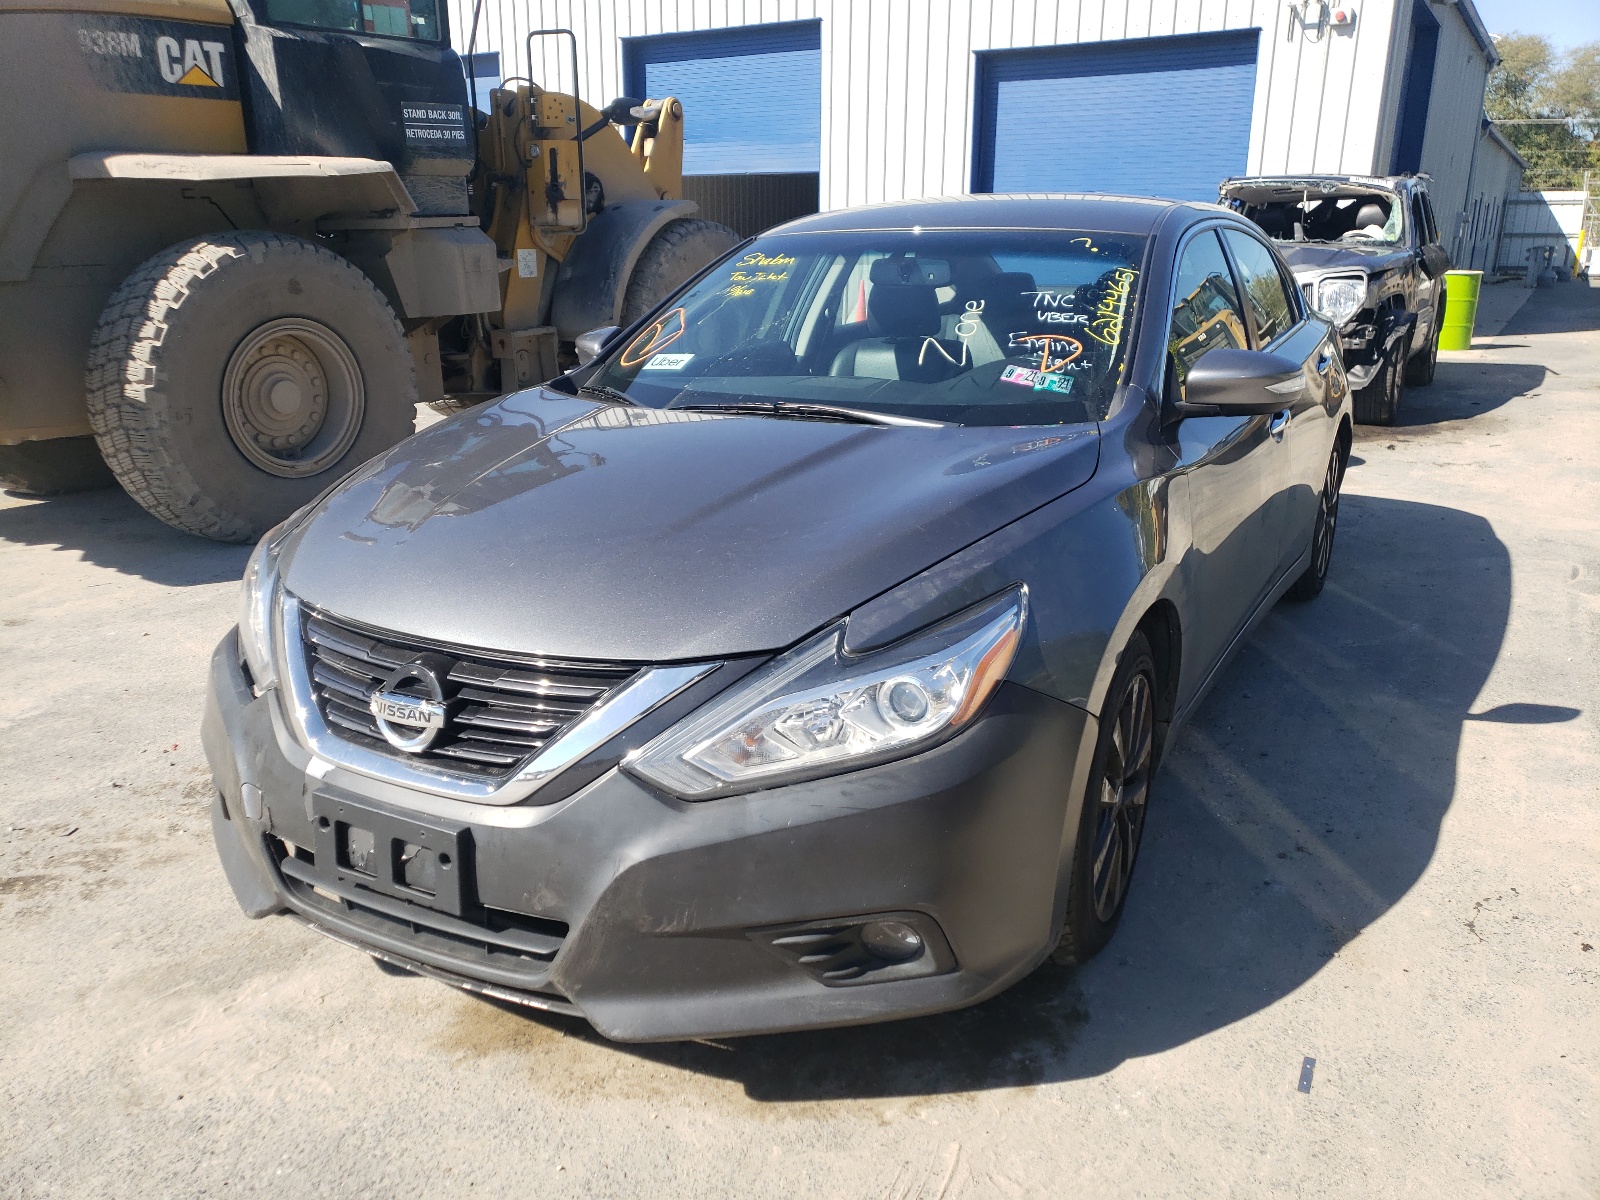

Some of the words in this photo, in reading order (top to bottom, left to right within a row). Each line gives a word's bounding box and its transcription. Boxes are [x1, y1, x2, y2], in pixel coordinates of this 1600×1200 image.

[156, 36, 225, 88] CAT
[403, 108, 427, 119] STAND
[427, 109, 447, 120] BACK
[405, 128, 443, 139] RETROCEDA
[443, 130, 451, 139] 30
[451, 130, 465, 140] PIES
[1020, 290, 1076, 307] TNC
[1036, 310, 1090, 324] UBER
[651, 356, 685, 367] Uber
[375, 701, 431, 724] NISSAN
